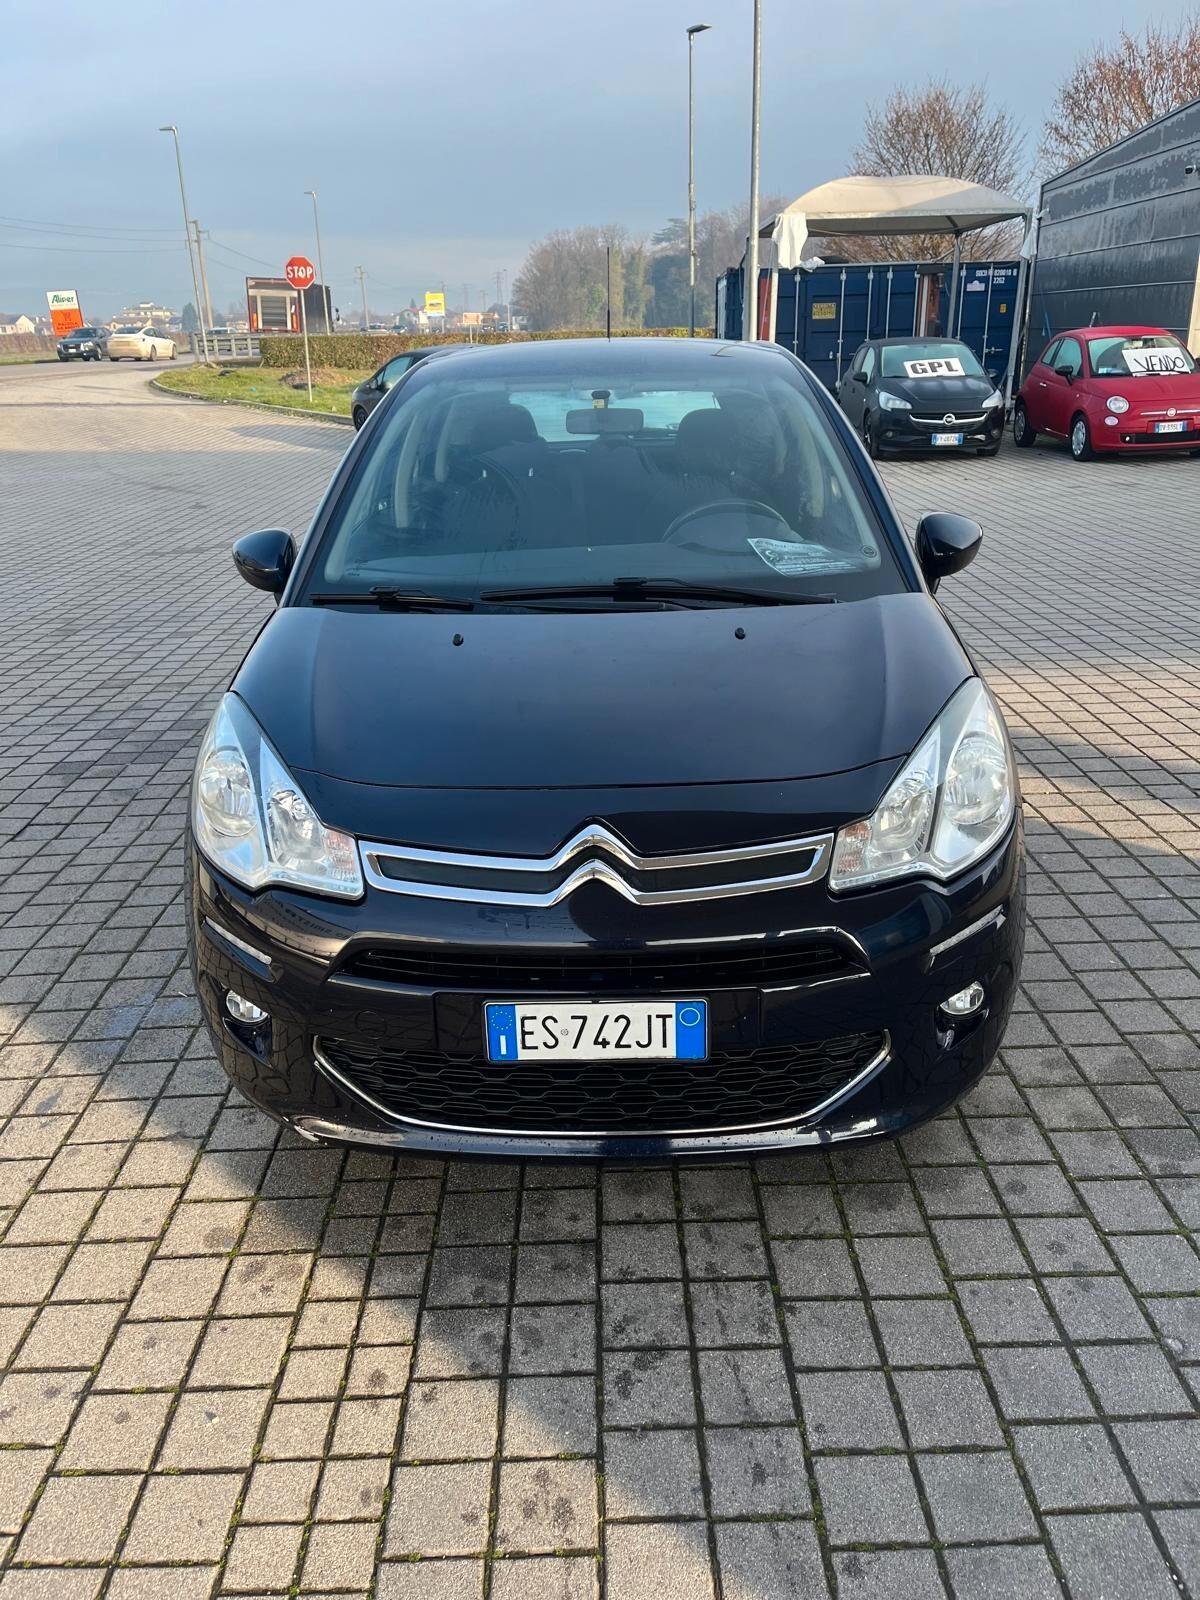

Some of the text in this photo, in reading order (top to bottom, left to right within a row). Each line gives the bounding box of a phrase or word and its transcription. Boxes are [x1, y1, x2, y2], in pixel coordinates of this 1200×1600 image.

[287, 266, 313, 278] STOP
[910, 361, 959, 375] GPL
[1133, 354, 1185, 371] VENDO
[520, 1014, 673, 1050] ES 742JT
